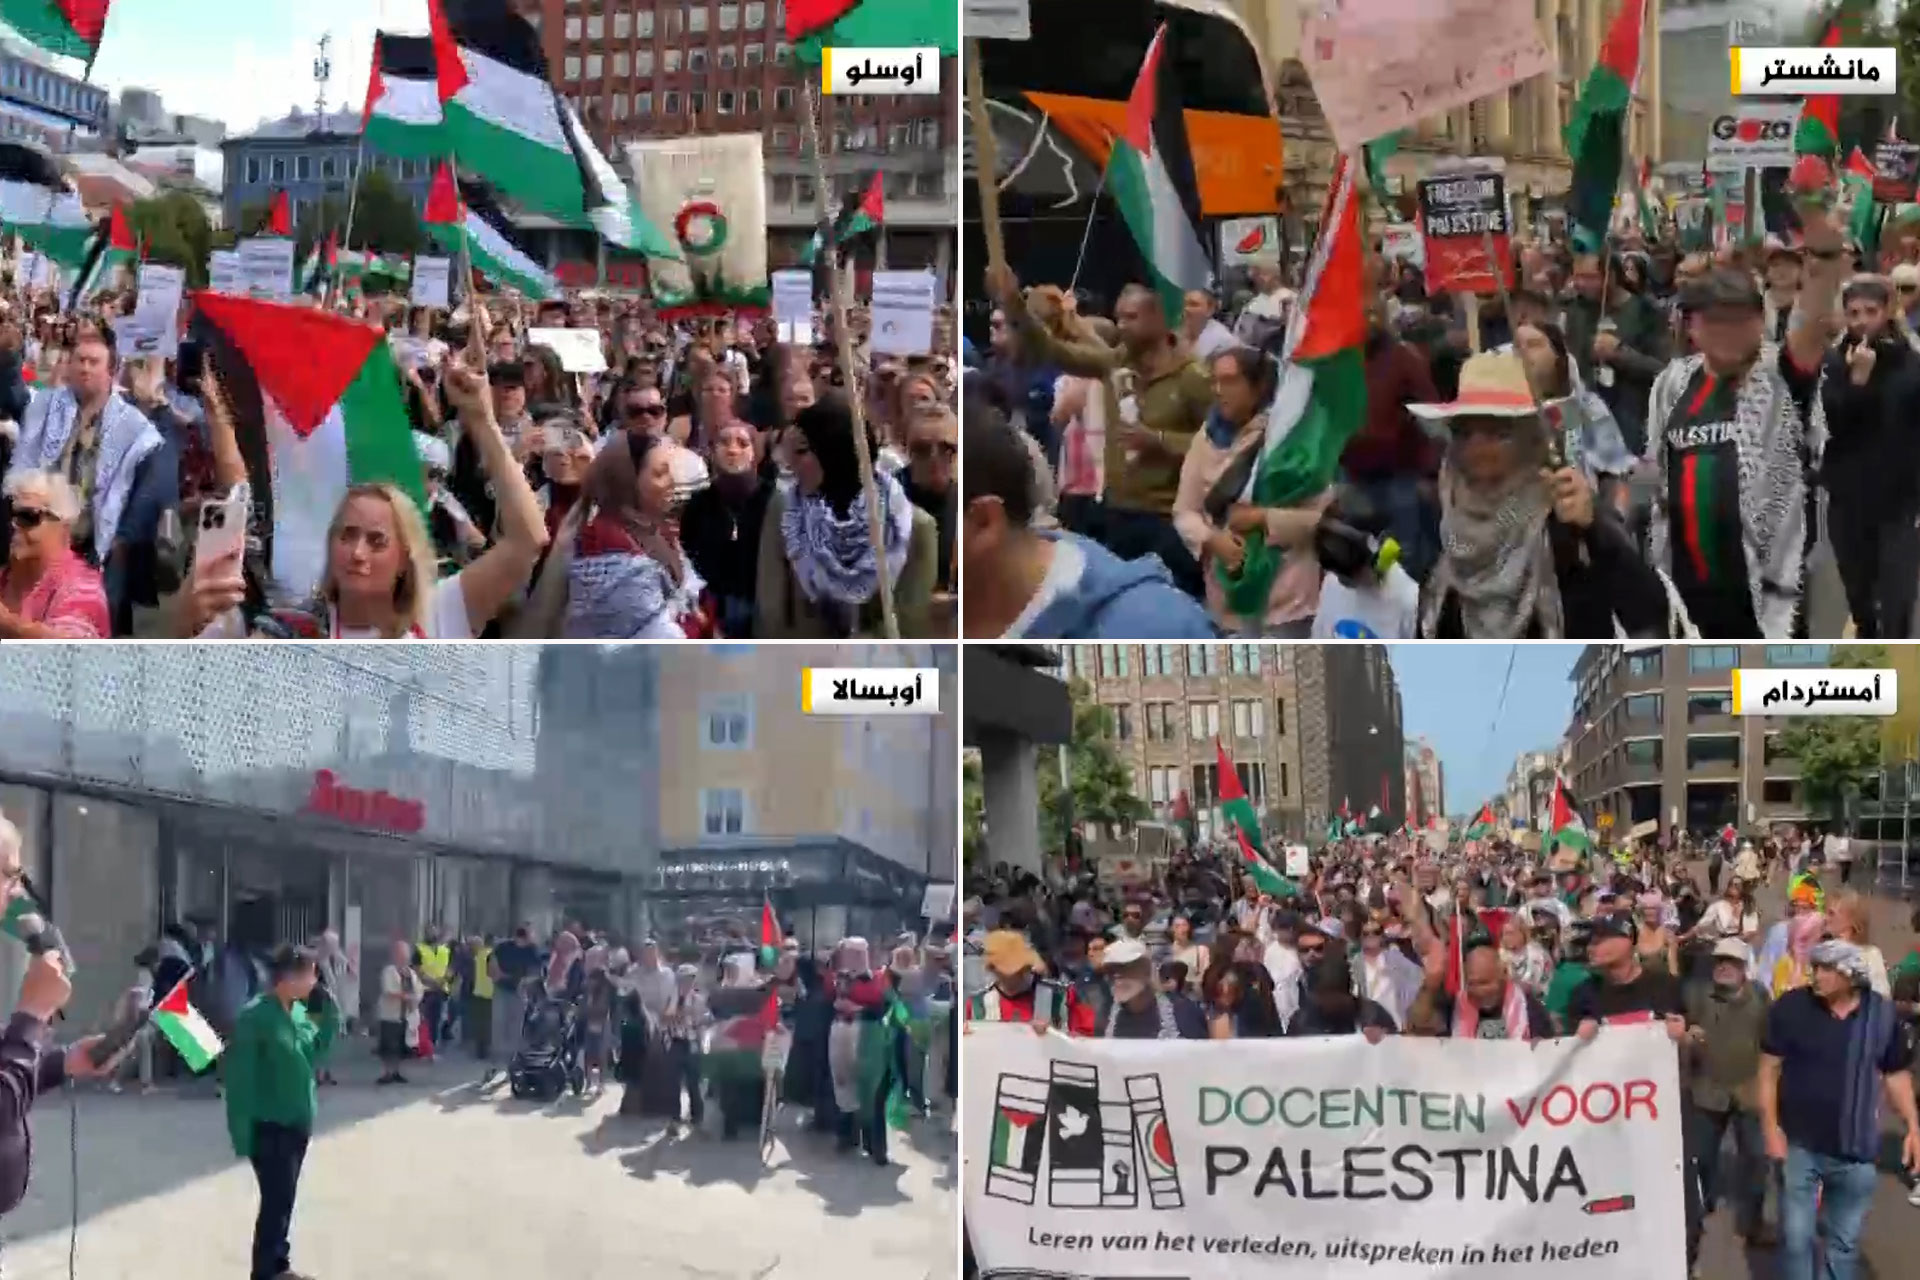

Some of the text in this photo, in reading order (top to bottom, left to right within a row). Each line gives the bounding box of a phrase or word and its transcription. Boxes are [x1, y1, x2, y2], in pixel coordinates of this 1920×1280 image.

[1198, 1079, 1658, 1133] DOCENTEN VOOR
[1204, 1144, 1588, 1202] PALESTINA
[1028, 1227, 1619, 1264] Leren van het verleden, uitspreken in het heden
